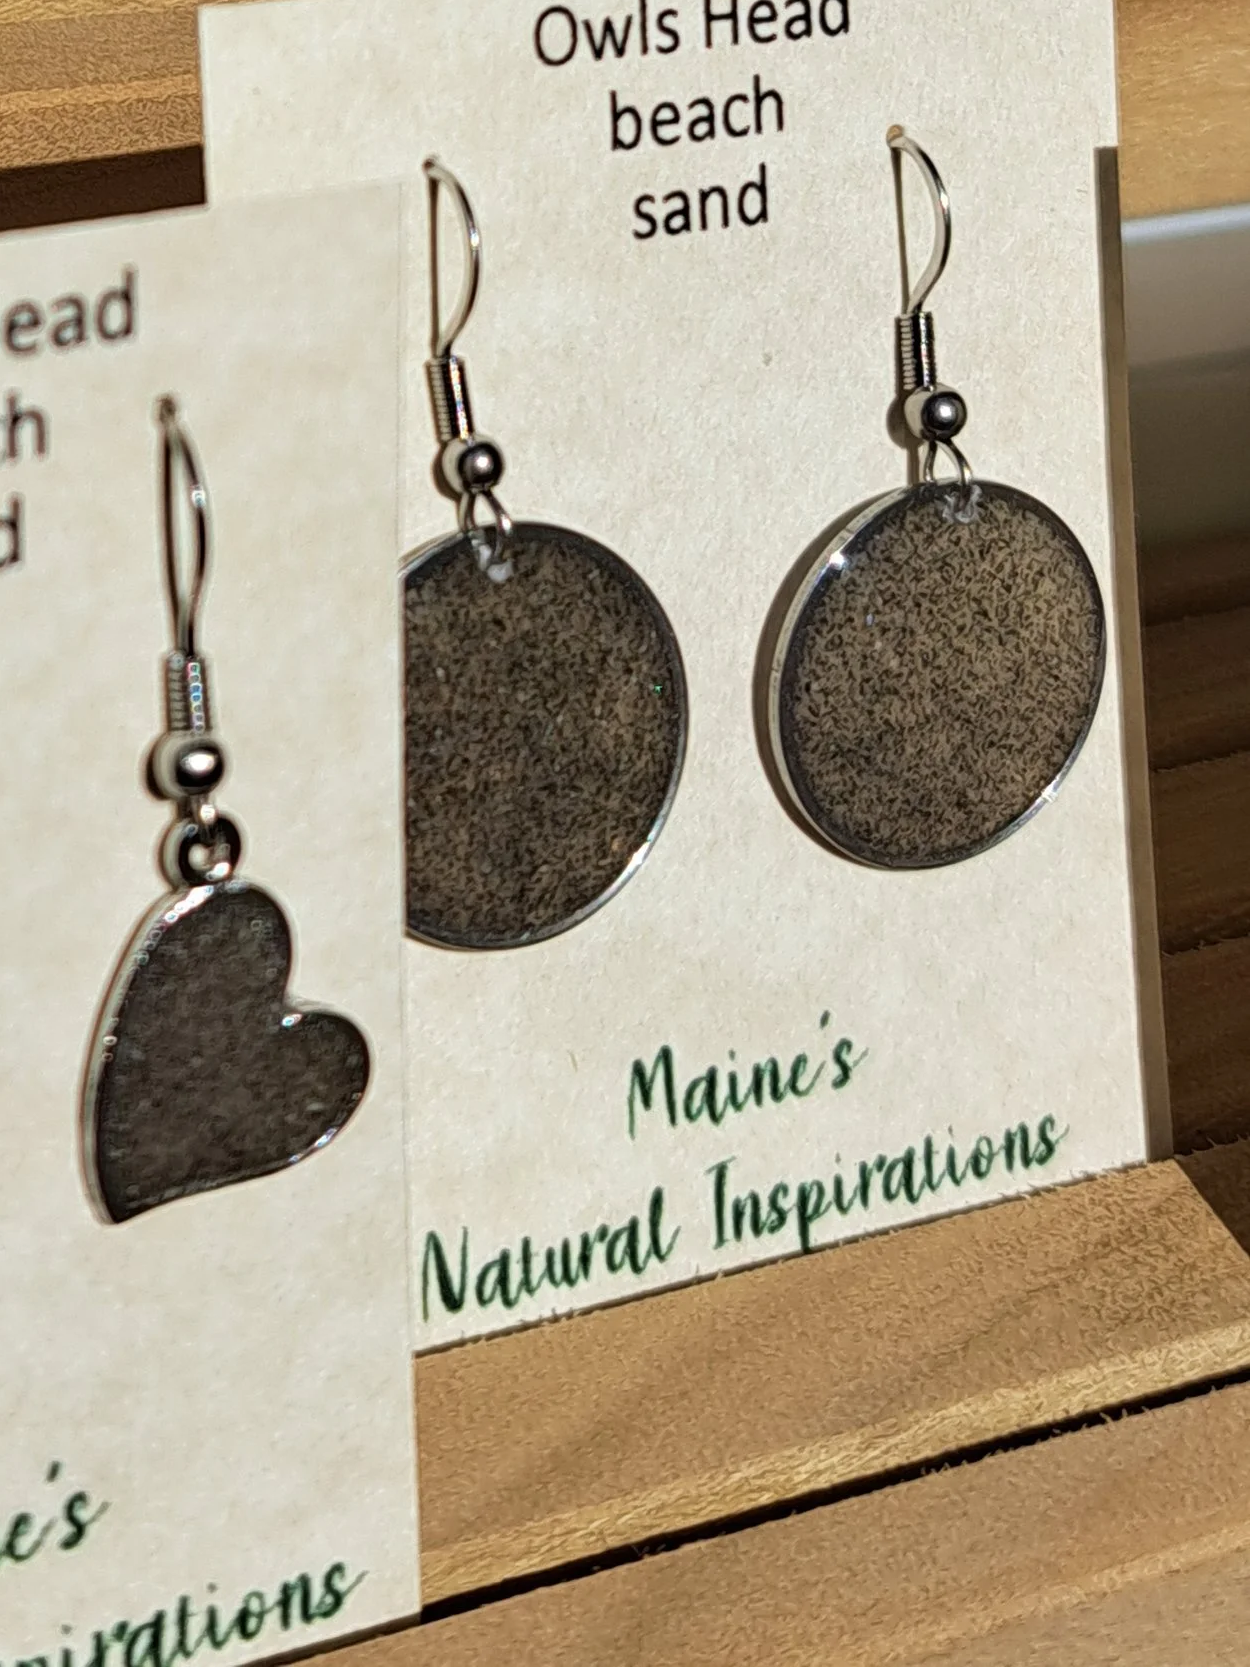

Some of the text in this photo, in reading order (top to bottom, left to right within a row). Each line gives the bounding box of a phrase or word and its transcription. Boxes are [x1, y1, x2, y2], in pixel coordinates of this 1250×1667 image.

[610, 74, 785, 151] beach
[633, 163, 770, 240] sand
[627, 1009, 871, 1139] Maine's
[421, 1114, 1070, 1321] Natural Inspirations
